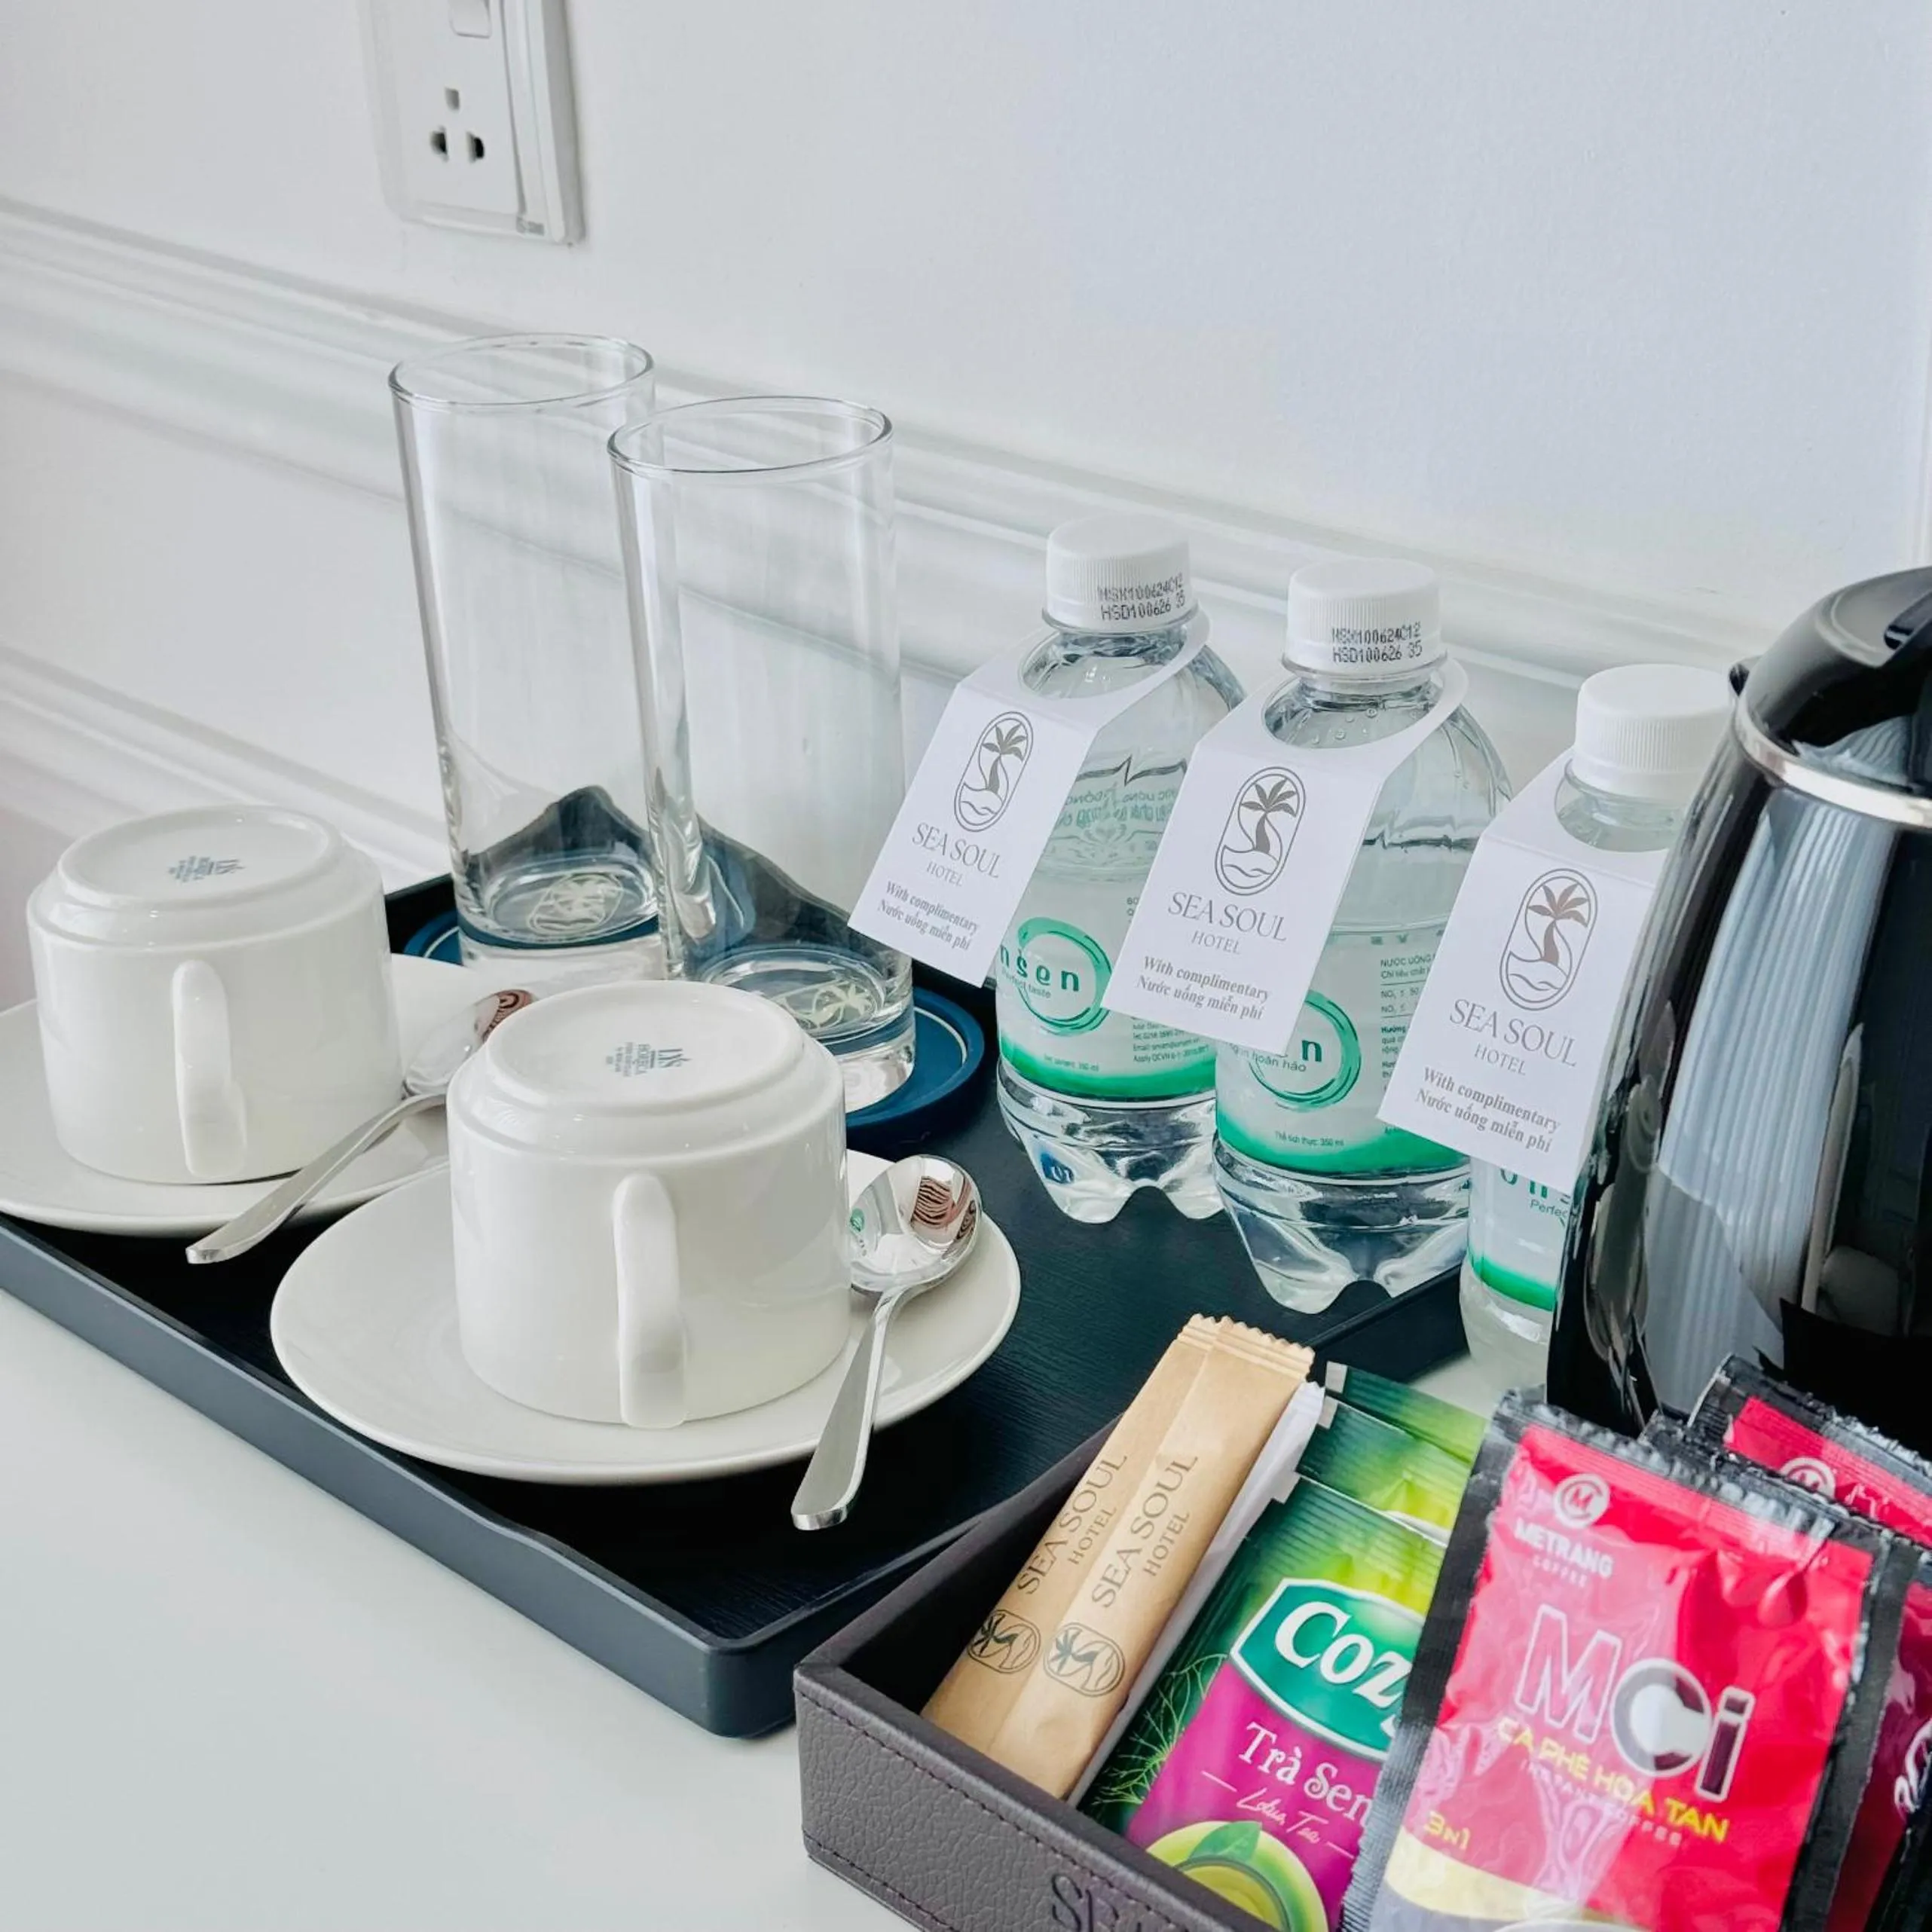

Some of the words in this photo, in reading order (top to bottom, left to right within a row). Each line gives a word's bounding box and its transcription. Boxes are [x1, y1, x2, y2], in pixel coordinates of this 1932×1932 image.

[1101, 598, 1172, 621] HSD100626
[1332, 644, 1402, 663] HSD100626
[912, 822, 949, 856] SEA
[949, 838, 1001, 879] SOUL
[926, 861, 964, 887] HOTEL
[885, 881, 909, 903] With
[909, 895, 979, 936] complimentary
[1167, 891, 1213, 924] SEA
[1219, 903, 1287, 942] SOUL
[999, 943, 1080, 992] nsen
[1191, 930, 1242, 955] HOTEL
[1136, 974, 1171, 996] Nước
[1174, 984, 1205, 1009] uống
[1206, 995, 1239, 1014] miễn
[1239, 1006, 1265, 1020] phí
[1144, 955, 1174, 977] With
[1176, 967, 1270, 1005] complimentary
[1449, 998, 1499, 1039] SEA
[1503, 1018, 1578, 1068] SOUL
[1474, 1043, 1527, 1076] HOTEL
[1416, 1087, 1452, 1114] Nước
[1454, 1103, 1489, 1132] uống
[1490, 1120, 1526, 1142] miễn
[1525, 1135, 1554, 1154] phí
[1423, 1067, 1455, 1093] With
[1457, 1084, 1562, 1134] complimentary
[1530, 1199, 1569, 1218] Perfec
[1017, 1537, 1068, 1595] SEA
[1058, 1454, 1128, 1535] SOUL
[1068, 1505, 1117, 1566] HOTEL
[1091, 1548, 1142, 1609] SEA
[1130, 1455, 1199, 1542] SOUL
[1143, 1509, 1191, 1577] HOTEL
[1514, 1516, 1614, 1579] METRANG
[1275, 1601, 1414, 1709] Coz
[1238, 1722, 1302, 1786] Trà
[1304, 1761, 1372, 1829] Sen
[1665, 1796, 1730, 1843] TAN
